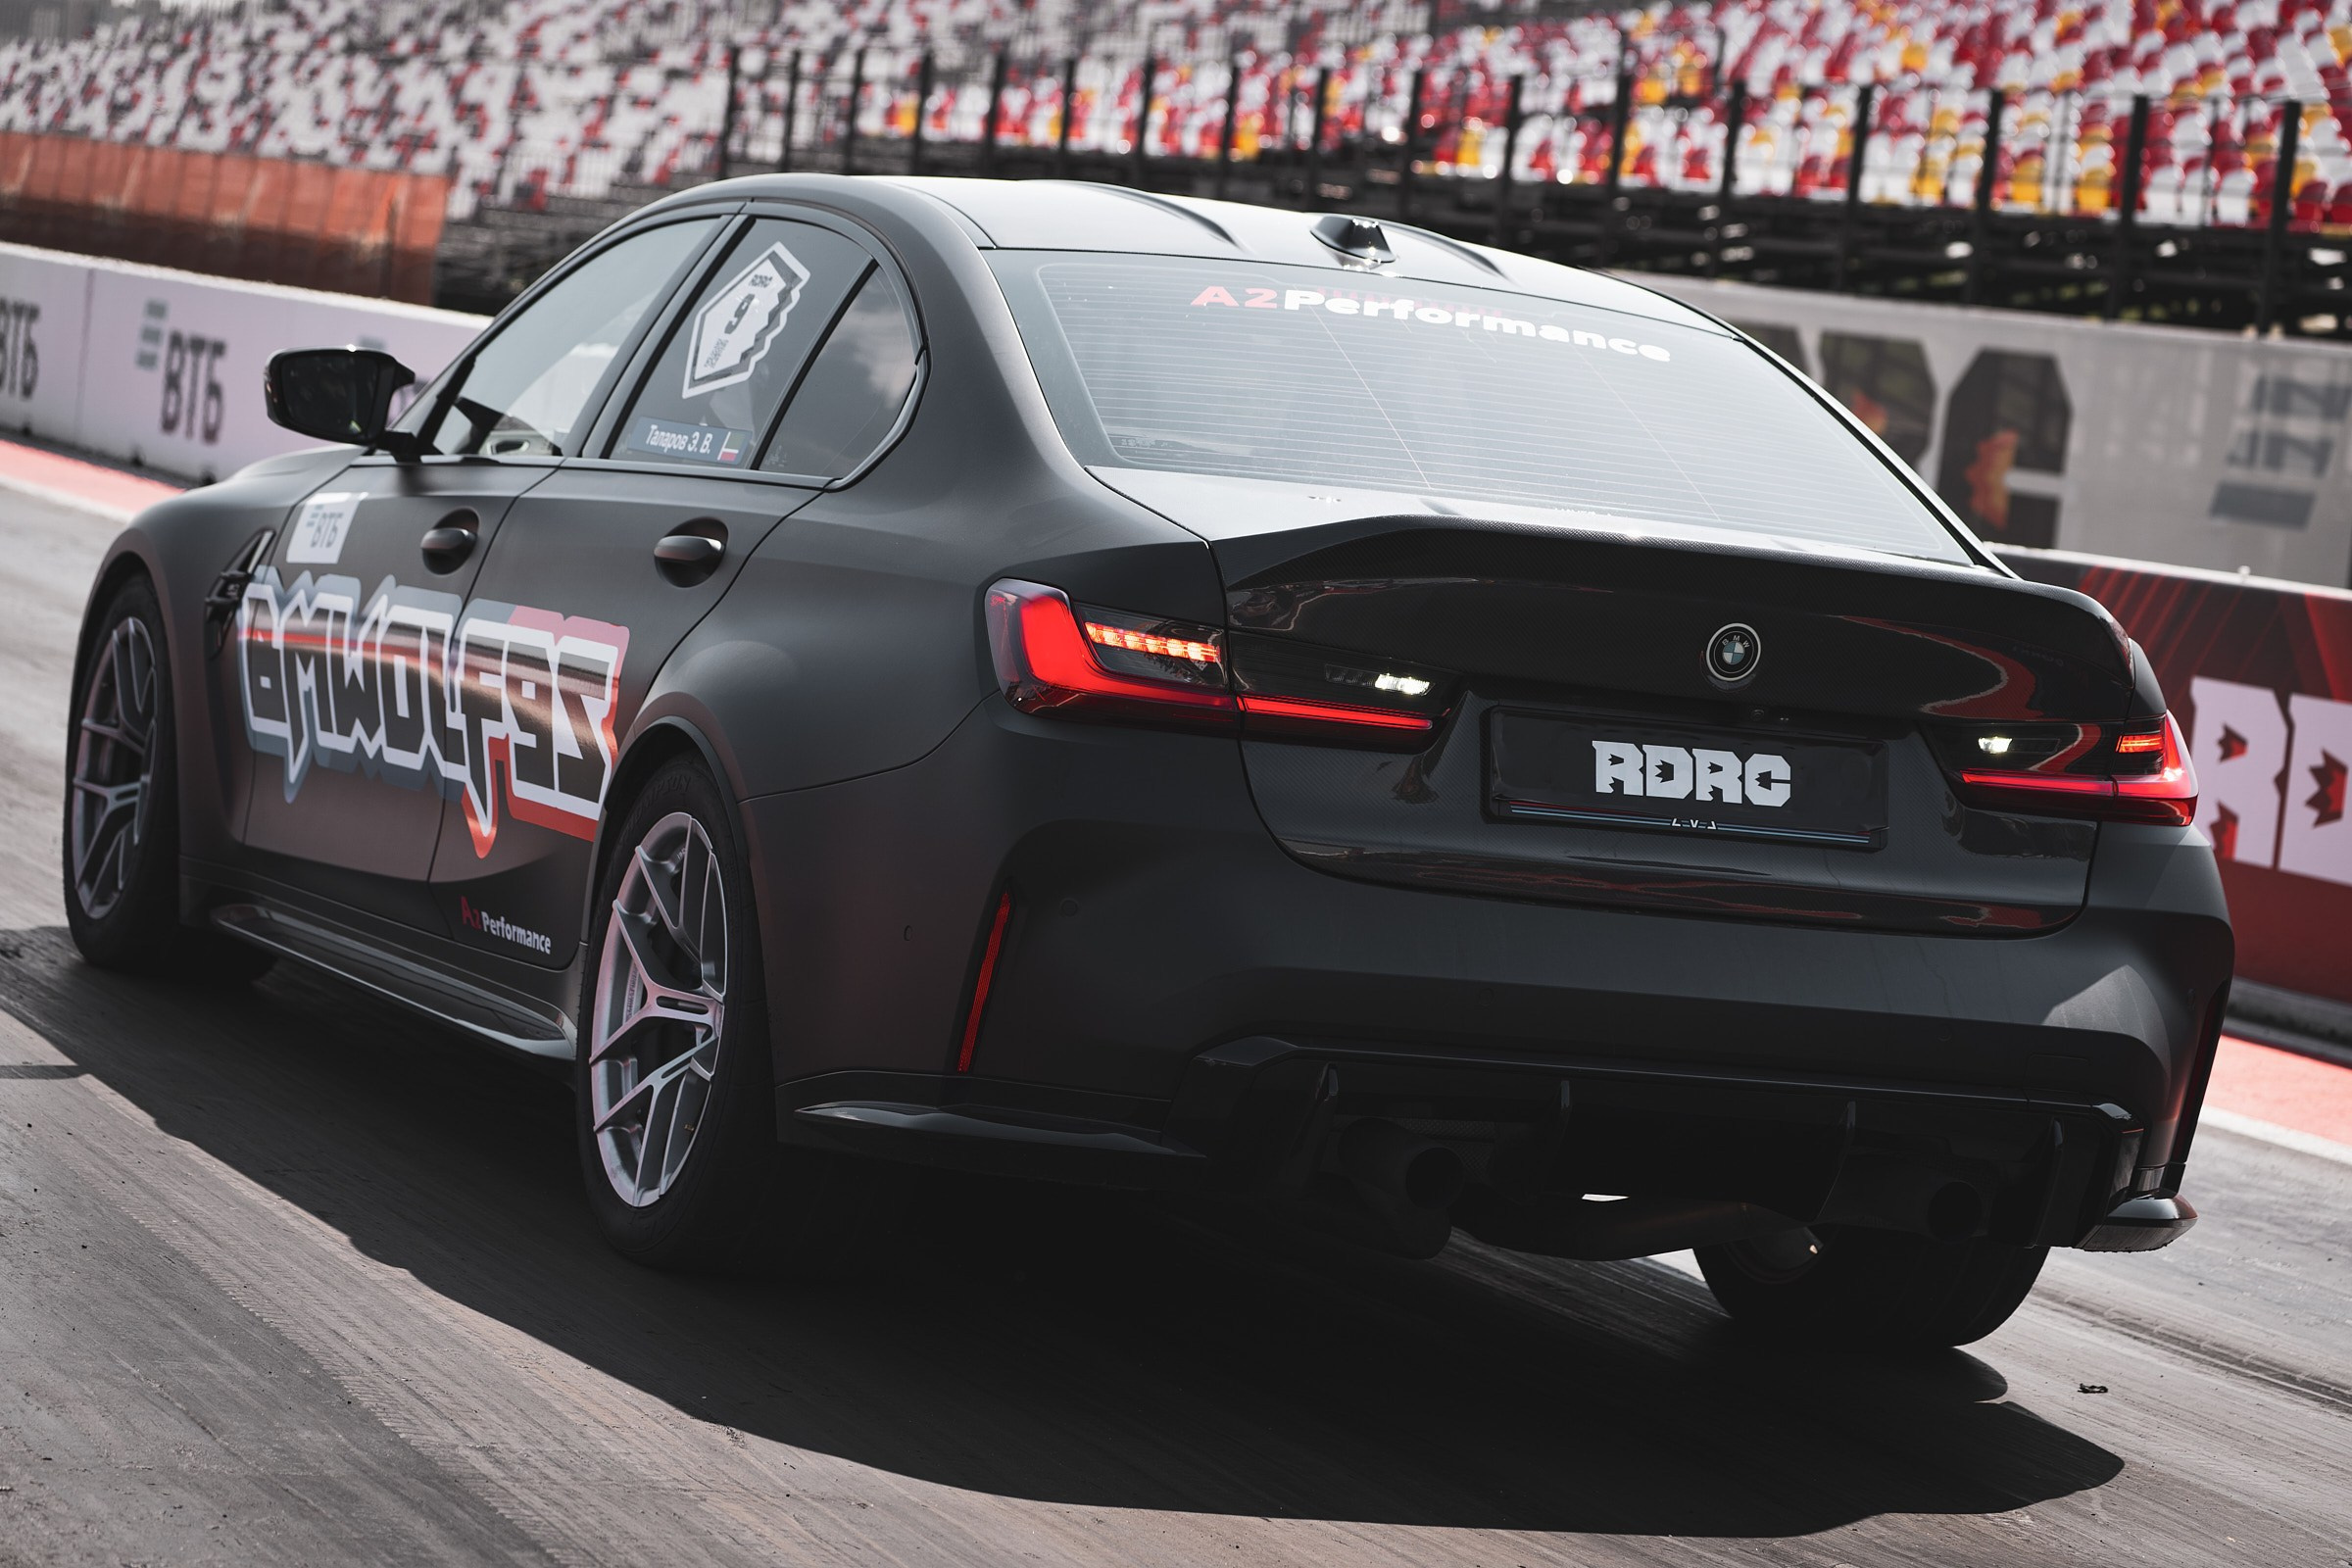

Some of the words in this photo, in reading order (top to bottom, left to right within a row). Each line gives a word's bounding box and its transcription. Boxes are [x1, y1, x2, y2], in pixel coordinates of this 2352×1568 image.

[160, 328, 227, 446] ВТБ
[310, 512, 344, 548] ВТБ
[1722, 634, 1750, 648] BMW
[1592, 739, 1791, 808] RDRC
